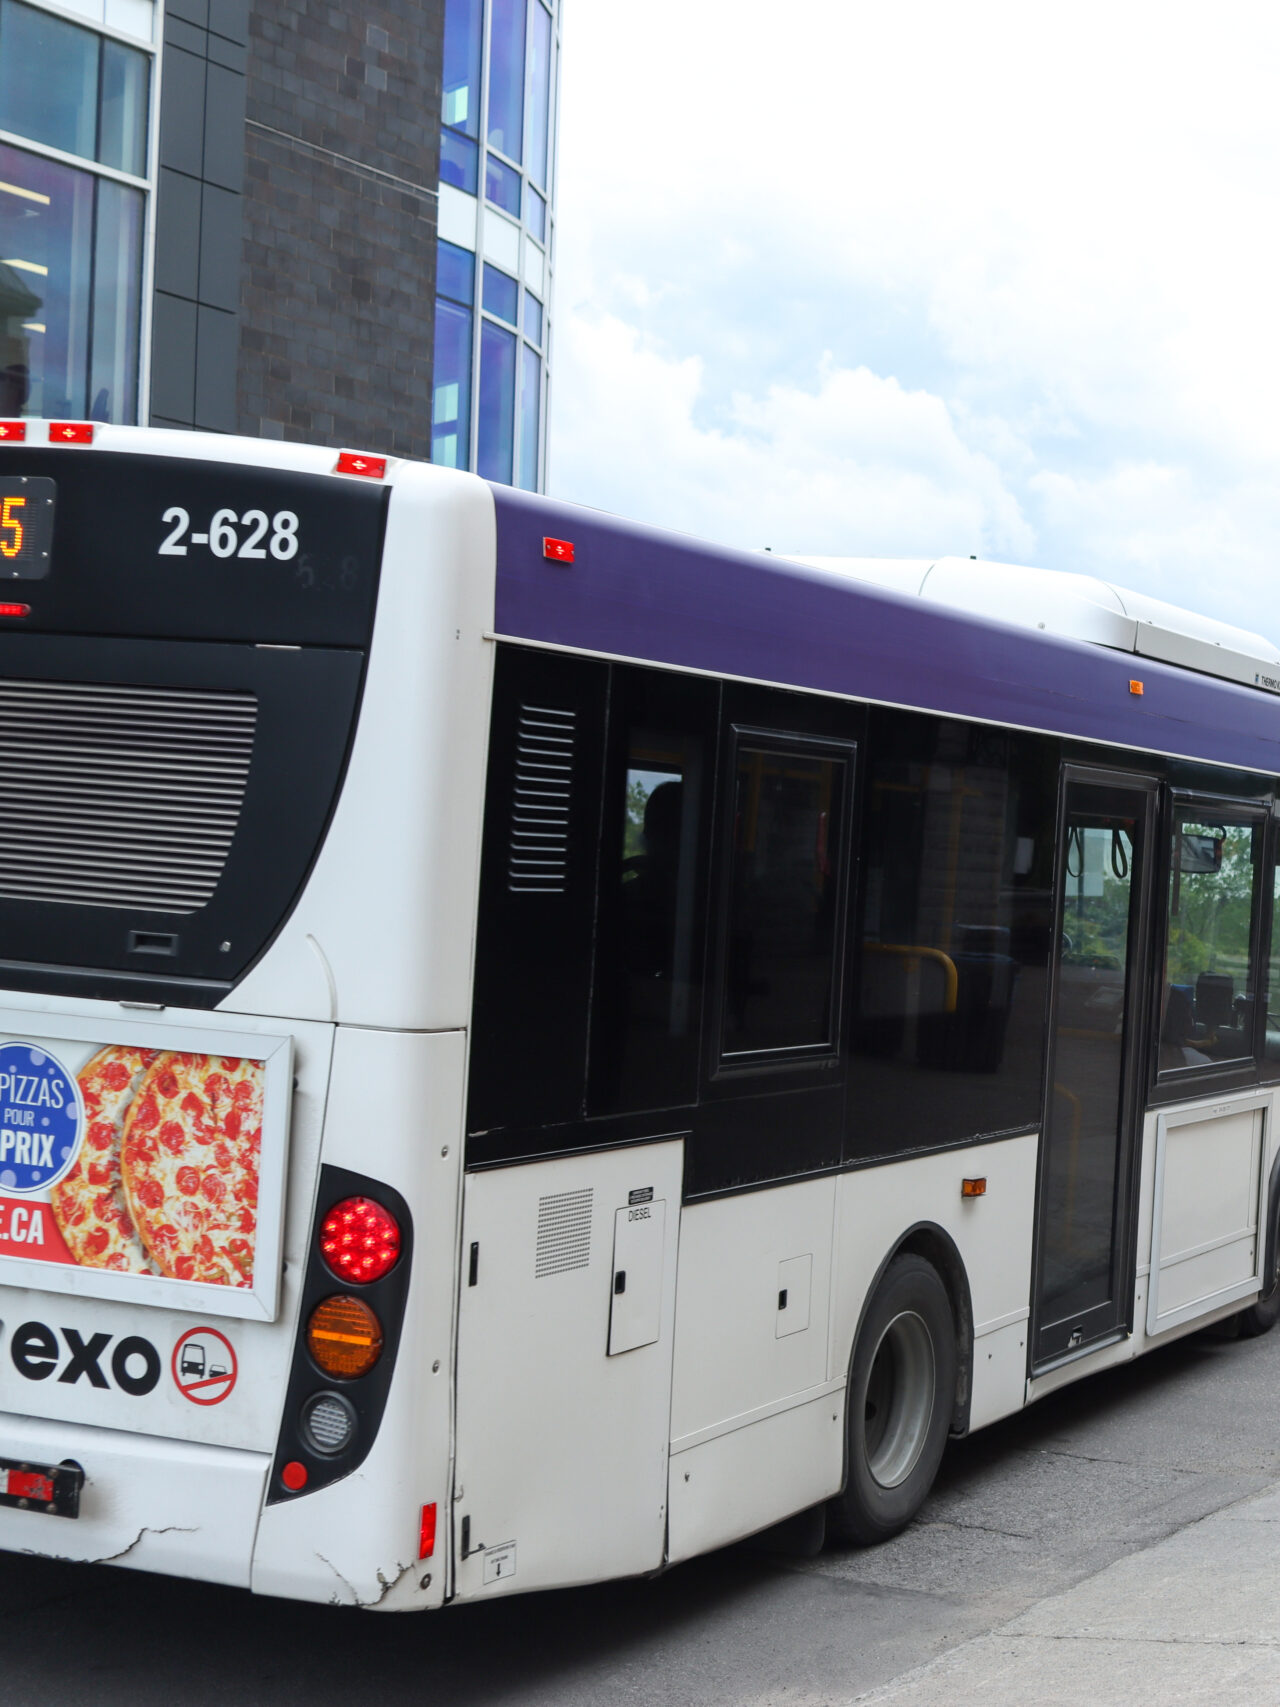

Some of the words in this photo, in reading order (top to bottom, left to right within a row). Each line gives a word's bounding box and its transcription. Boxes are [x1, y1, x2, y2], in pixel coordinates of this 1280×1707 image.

[0, 497, 25, 556] 5
[158, 506, 299, 561] 2-628
[1261, 675, 1277, 690] THERMO
[0, 1073, 65, 1109] PIZZAS
[4, 1107, 35, 1127] POUR
[0, 1129, 56, 1169] PRIX
[628, 1207, 651, 1222] DIESEL
[11, 1320, 162, 1397] exo
